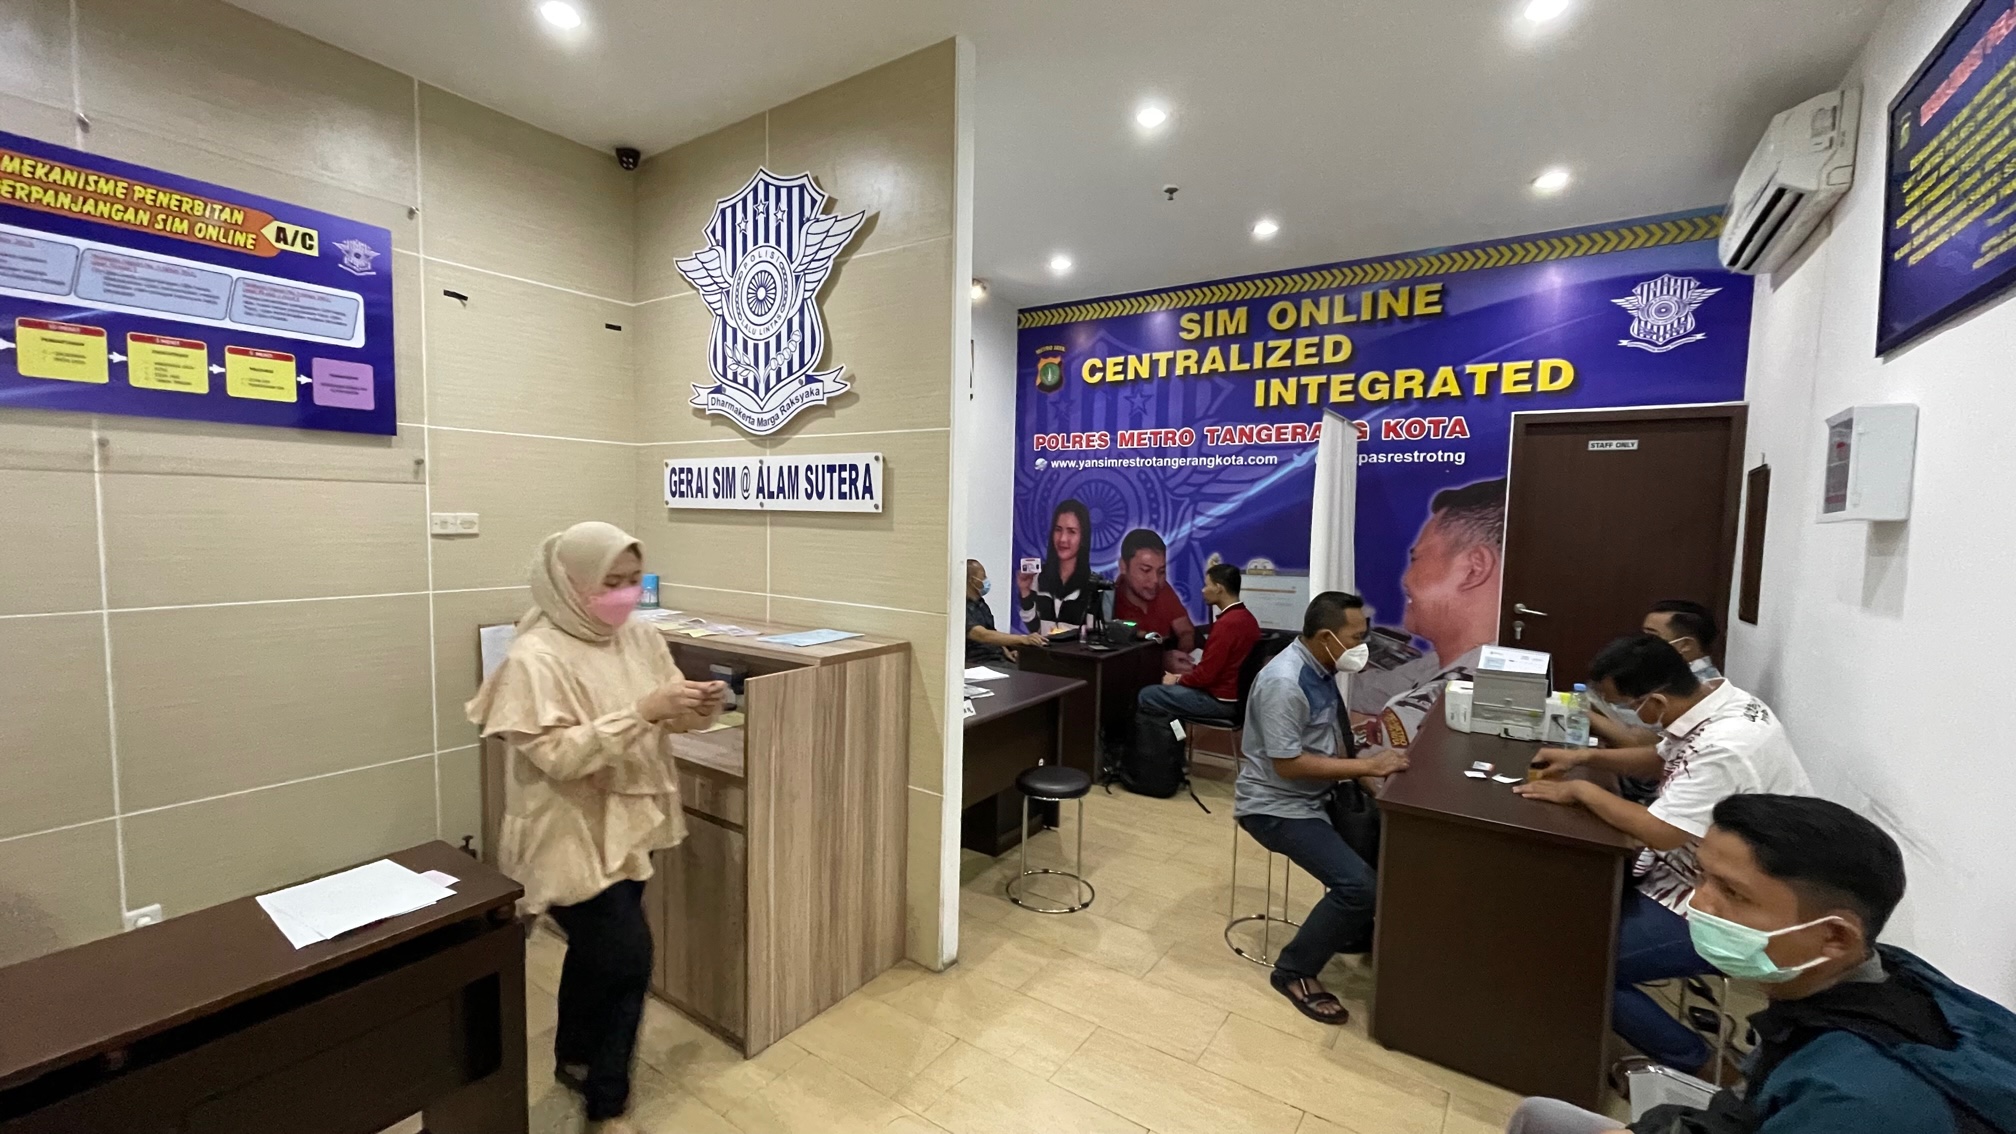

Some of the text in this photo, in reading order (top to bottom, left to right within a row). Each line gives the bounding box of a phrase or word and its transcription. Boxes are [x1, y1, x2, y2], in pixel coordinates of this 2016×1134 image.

[0, 154, 244, 226] MEKANISME PENERBITAN
[0, 179, 257, 250] ERPANJANGAN SIM ONLINE
[274, 225, 315, 251] A/C
[743, 249, 780, 270] POLISI
[1179, 282, 1443, 340] SIM ONLINE
[1081, 334, 1353, 384] CENTRALIZED
[1254, 358, 1575, 407] INTEGRATED
[710, 387, 821, 427] Dharmakerta Marga Raksyaka
[1034, 416, 1470, 451] POLRES METRO TANGERAG KOTA
[669, 463, 874, 500] GERAI SIM @ ALAM SUTERA
[1050, 454, 1278, 471] www.yansimrestrotangerangkota.com
